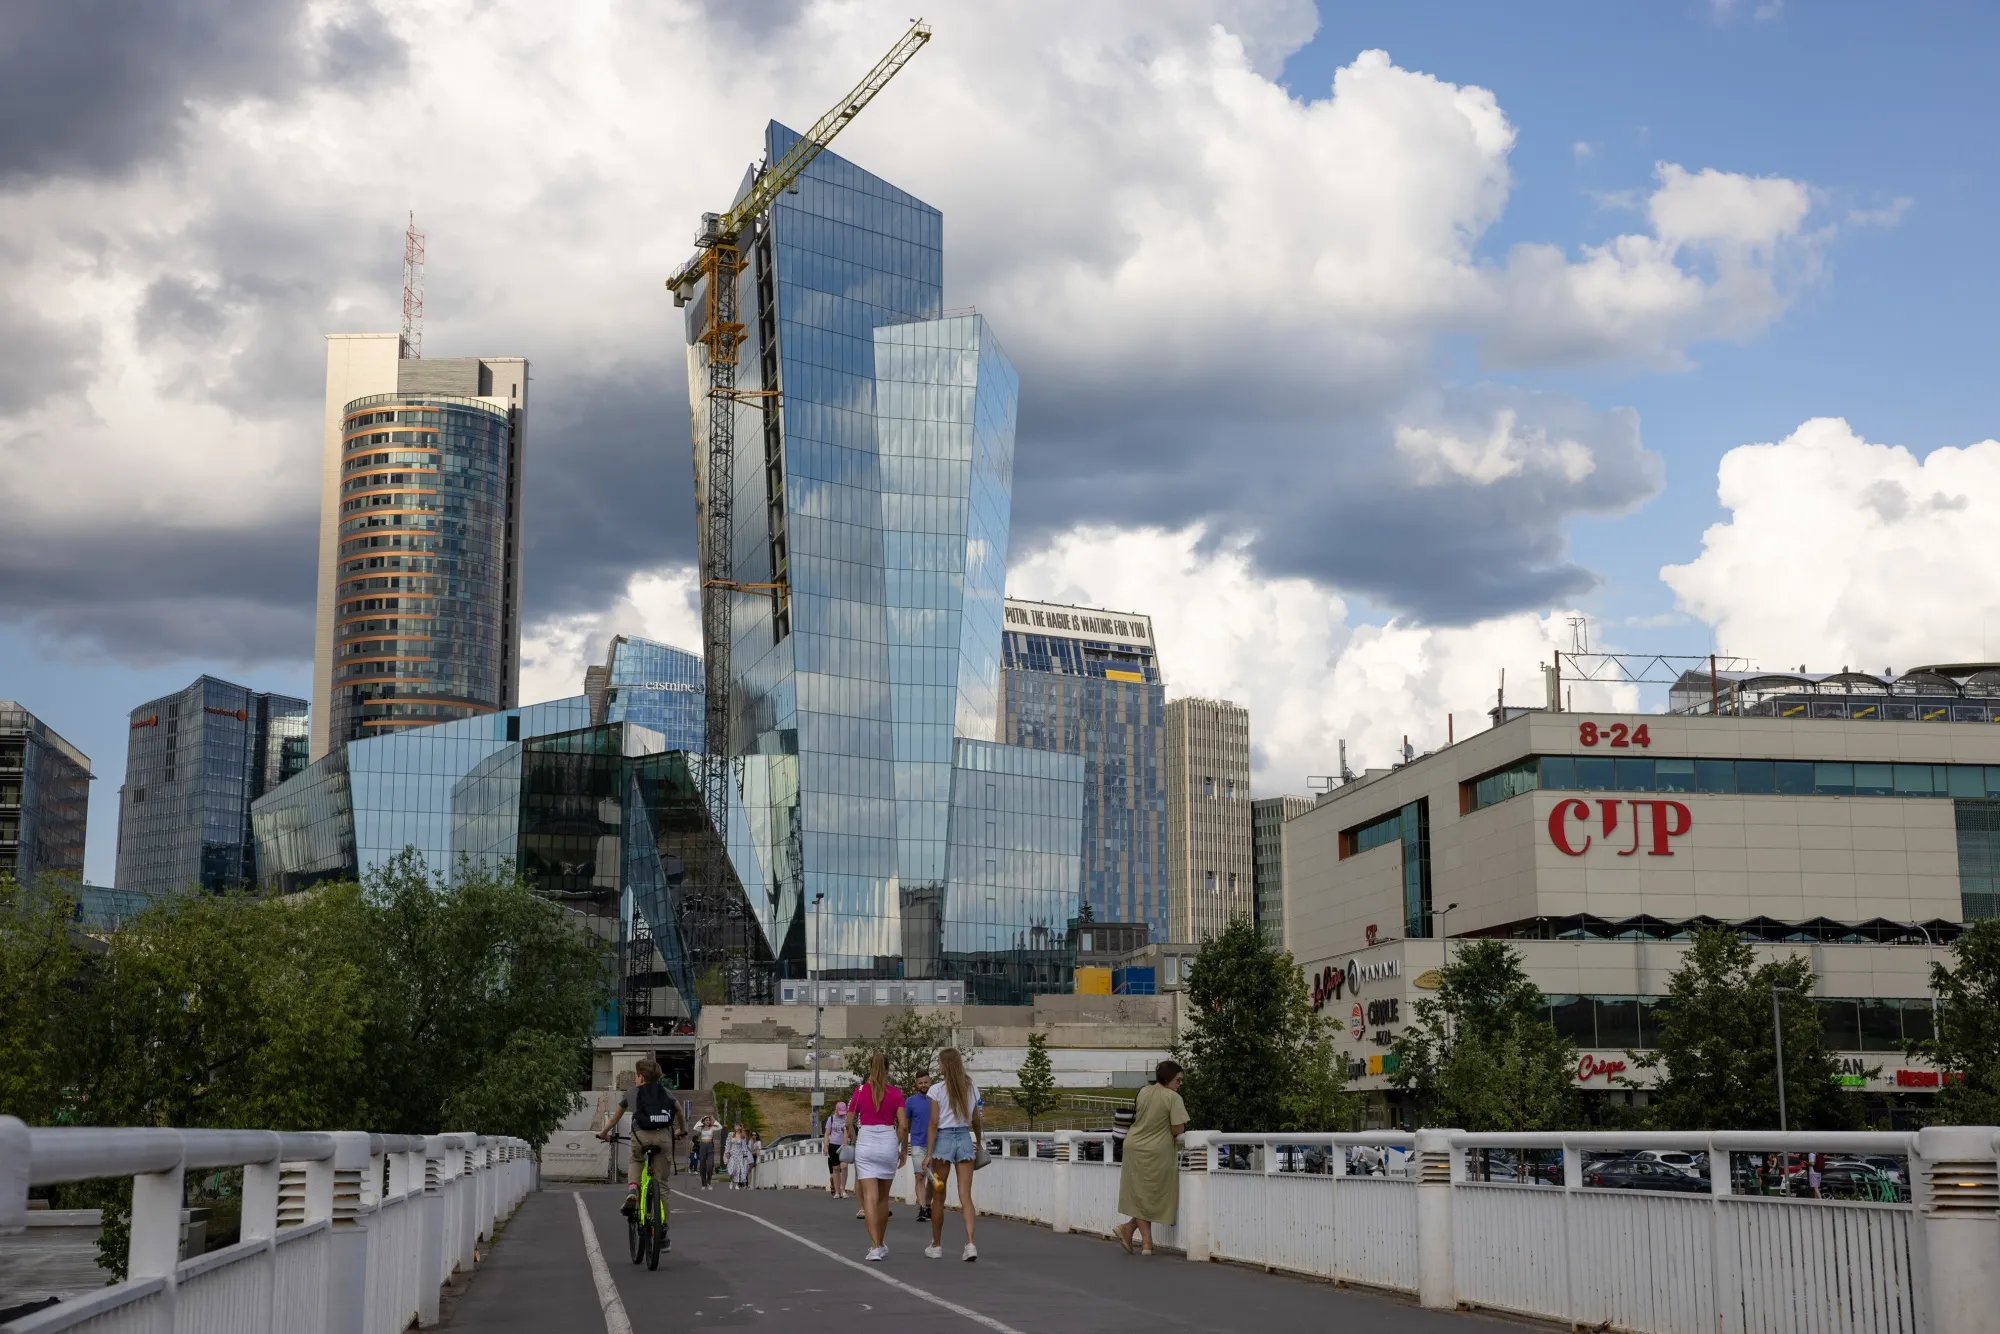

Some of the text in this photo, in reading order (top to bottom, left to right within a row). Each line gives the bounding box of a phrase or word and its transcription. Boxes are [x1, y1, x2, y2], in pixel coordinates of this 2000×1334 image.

[1005, 607, 1146, 638] PUTIN, THE HAGUE IS WAITING FOR YOU
[1580, 722, 1650, 748] 8-24
[1548, 799, 1692, 856] CUP
[1361, 960, 1400, 982] MANAMI
[1578, 1054, 1626, 1083] Crêpe
